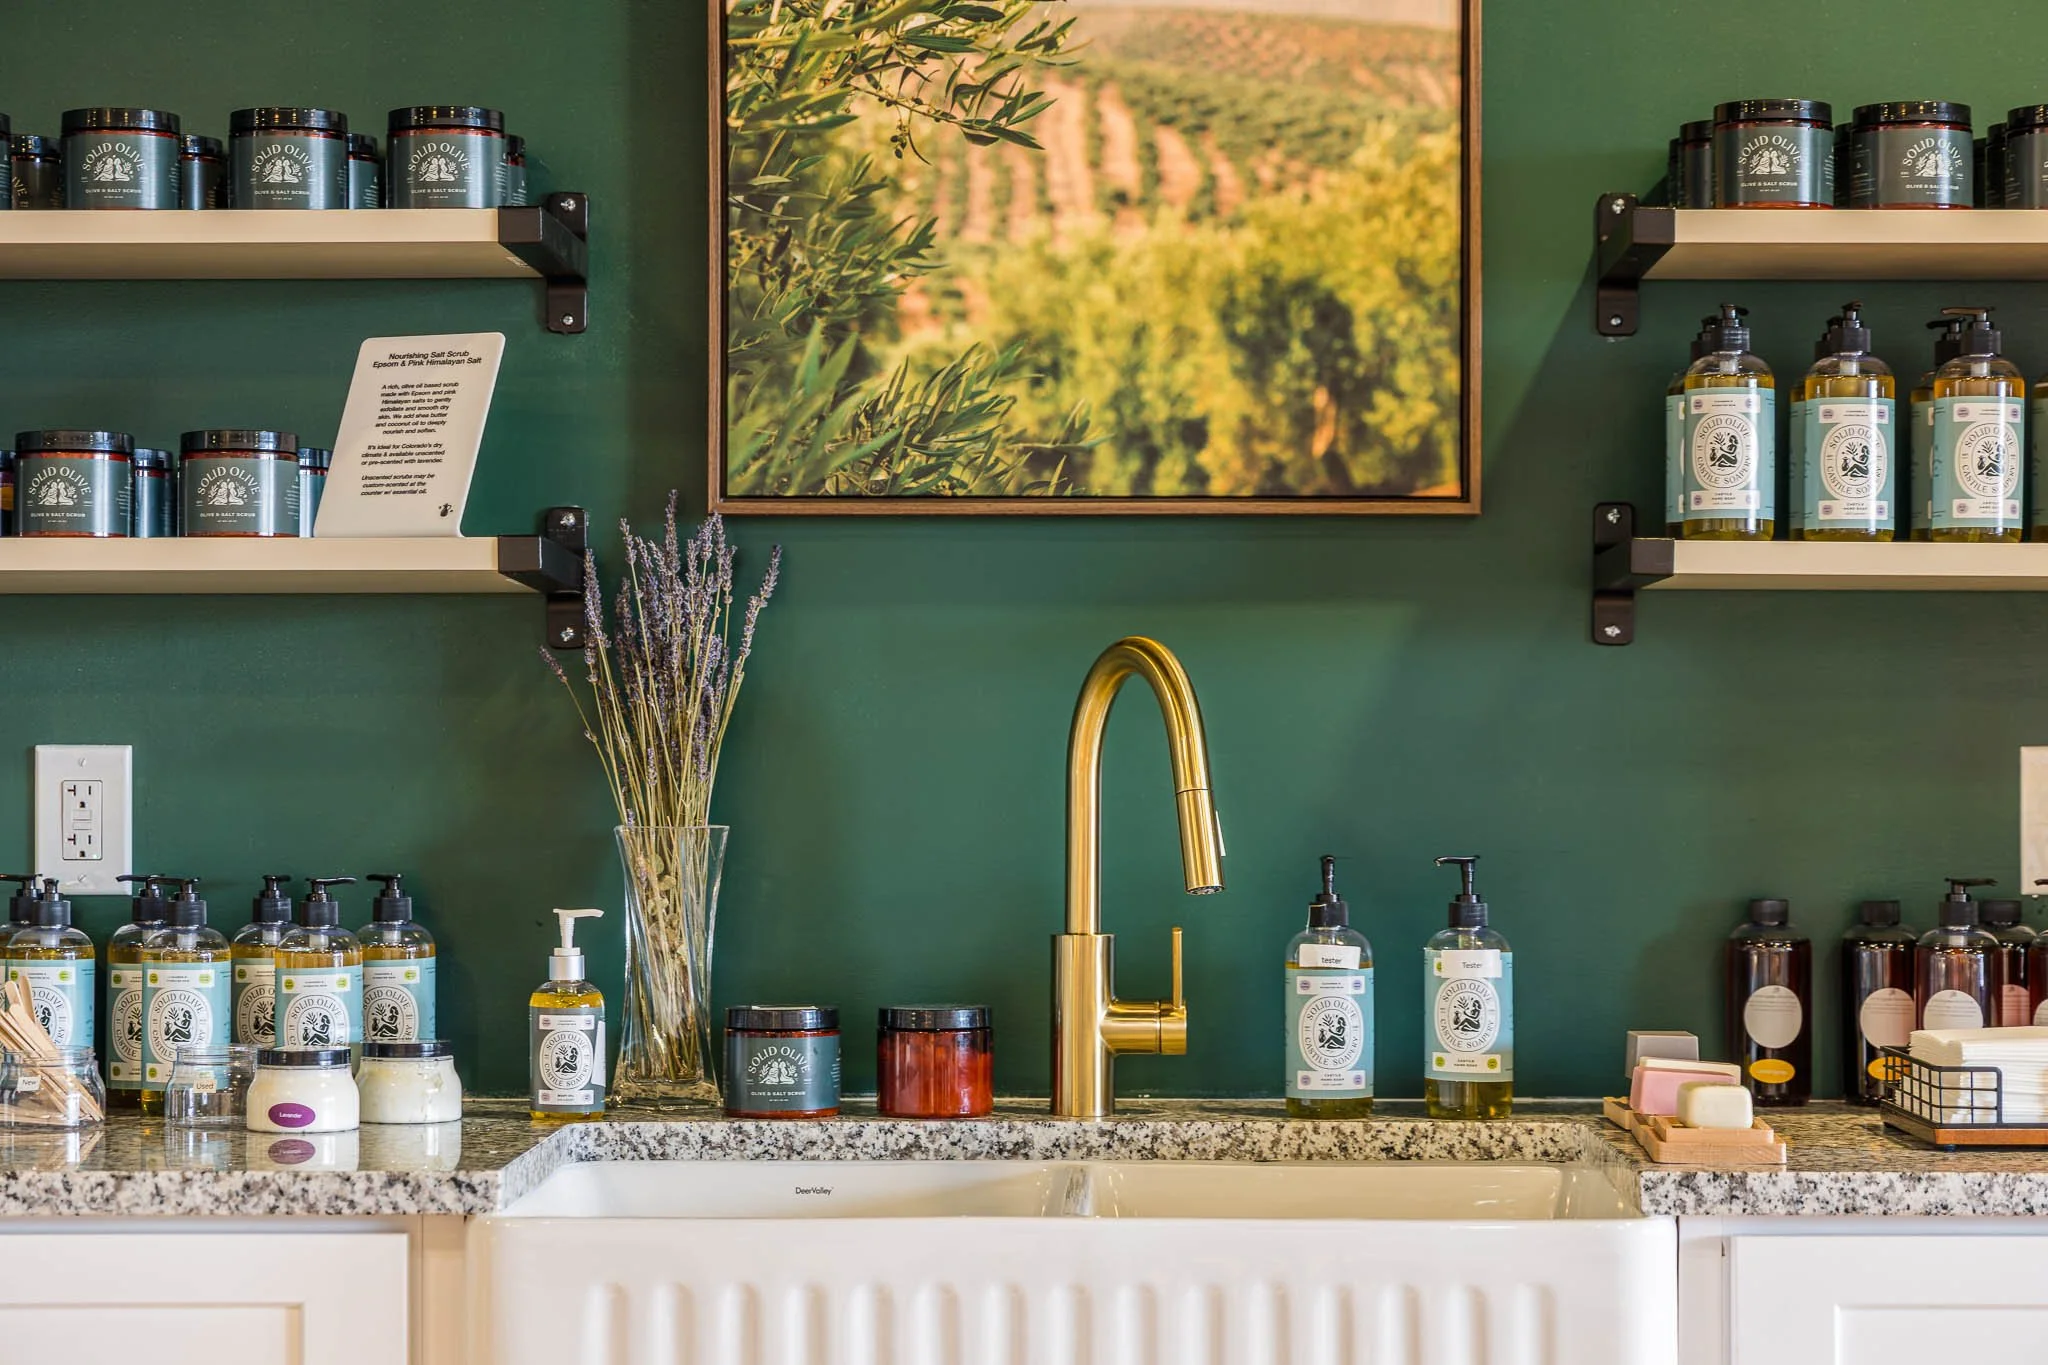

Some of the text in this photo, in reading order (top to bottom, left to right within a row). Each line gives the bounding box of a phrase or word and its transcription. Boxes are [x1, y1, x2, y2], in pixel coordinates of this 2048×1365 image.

[82, 142, 146, 172] SOLID OLIVE
[251, 144, 315, 173] SOLID OLIVE
[408, 142, 472, 172] SOLID OLIVE
[1738, 135, 1802, 165] SOLID OLIVE
[1902, 137, 1964, 168] SOLID OLIVE
[372, 361, 399, 369] Epsom
[407, 359, 424, 367] Pink
[426, 358, 466, 366] Himalayan
[388, 350, 470, 360] Nourishing Salt Scrub
[411, 390, 430, 398] Epsom
[1699, 417, 1751, 440] SOLID OLIVE
[1829, 428, 1855, 449] SOLID
[1964, 426, 2016, 448] SOLID OIVE
[28, 466, 92, 495] SOLID OLIVE
[197, 466, 262, 495] SOLID OLIVE
[1696, 456, 1721, 485] CASTILE
[1826, 465, 1852, 495] CASTILE
[1961, 464, 1987, 494] CASTILE
[1321, 957, 1342, 965] tester
[1462, 961, 1483, 969] Tester
[38, 990, 65, 1009] OLIVE
[117, 993, 141, 1014] SOLID
[154, 992, 204, 1014] SOLID OLIVE
[243, 987, 266, 1008] SOLID
[363, 989, 410, 1010] SOLID OLIVE
[1442, 982, 1493, 1003] SOLID OLIVE
[291, 998, 342, 1019] SOLID OLIVE
[1306, 1000, 1357, 1020] SOLID OLIVE
[115, 1029, 138, 1058] CASTILE
[152, 1030, 174, 1059] CASTILE
[546, 1032, 588, 1050] SOLID OLIVE
[1440, 1019, 1495, 1048] CASTILE SOAPERY
[747, 1046, 777, 1074] SOLID
[780, 1046, 811, 1073] OLIVE
[1304, 1036, 1359, 1066] CASTILE SOAPERY
[196, 1081, 214, 1090] Used
[544, 1063, 564, 1087] CASTILE
